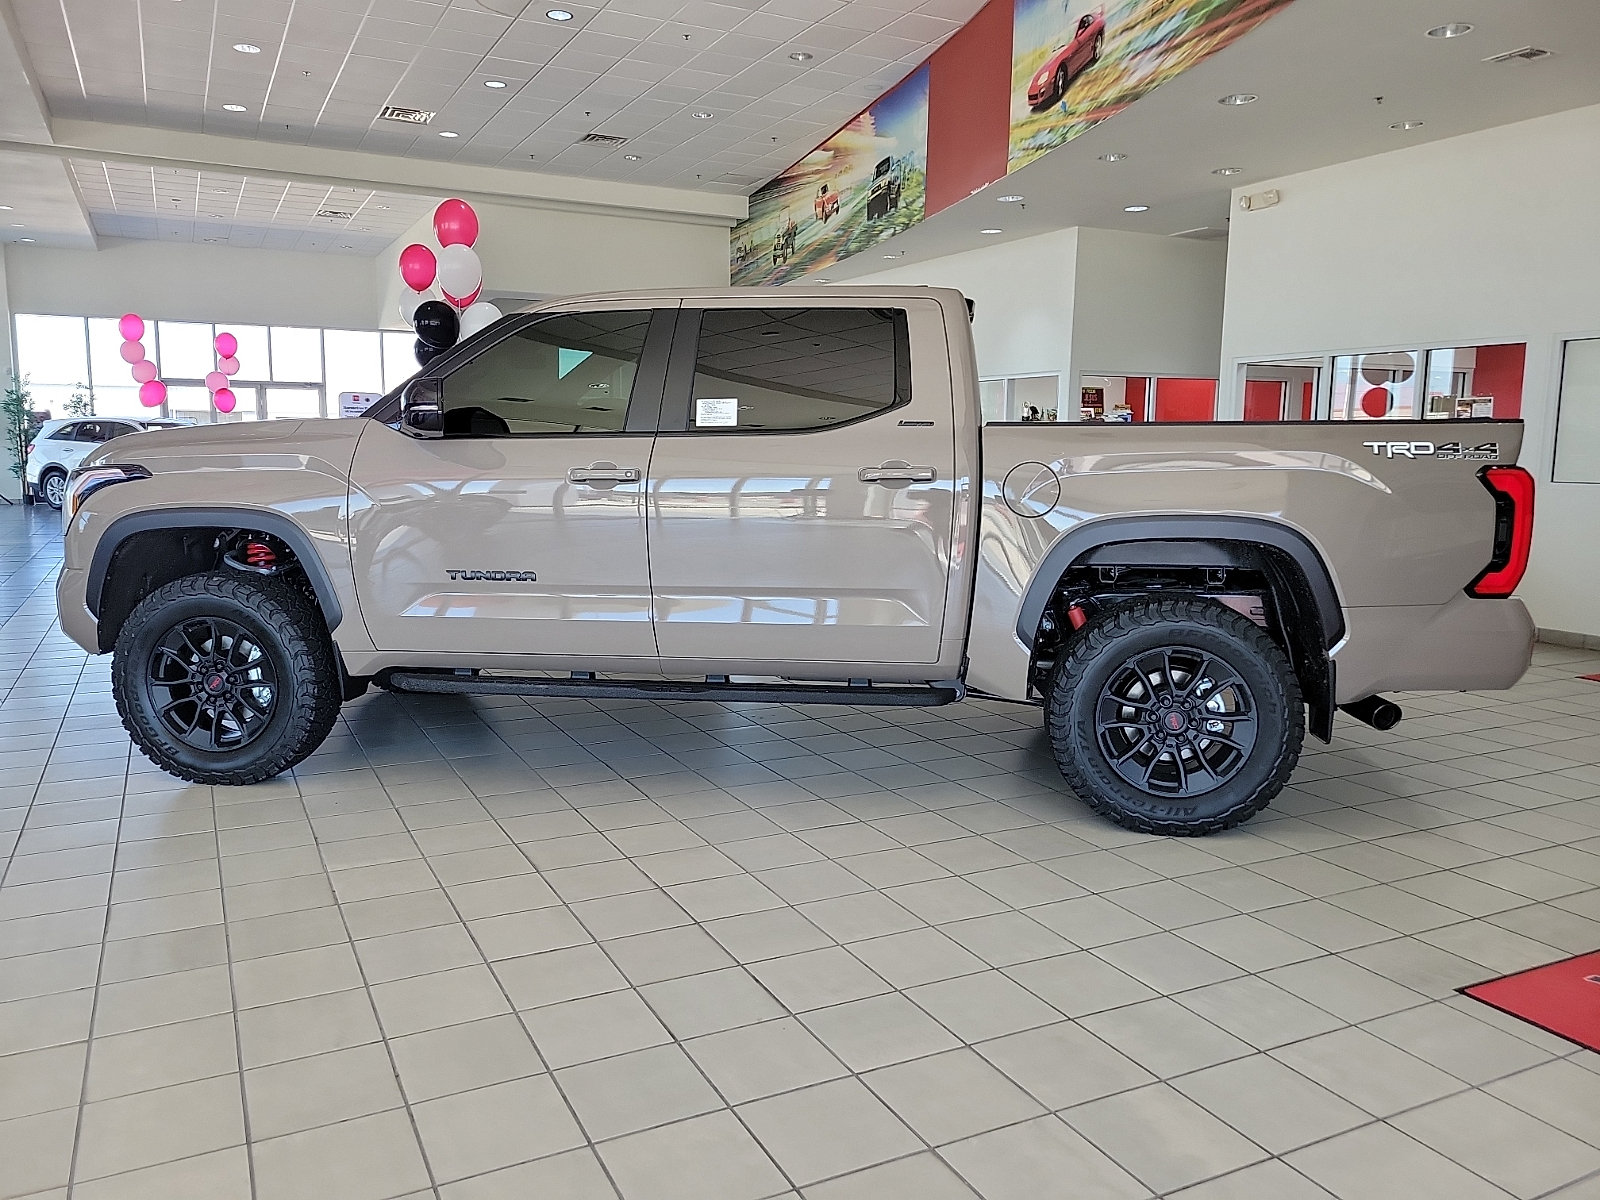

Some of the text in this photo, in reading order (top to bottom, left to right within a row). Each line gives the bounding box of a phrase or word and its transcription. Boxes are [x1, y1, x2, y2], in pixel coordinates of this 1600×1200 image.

[1362, 441, 1499, 459] TRD 4x4
[445, 569, 537, 582] TUNDRA
